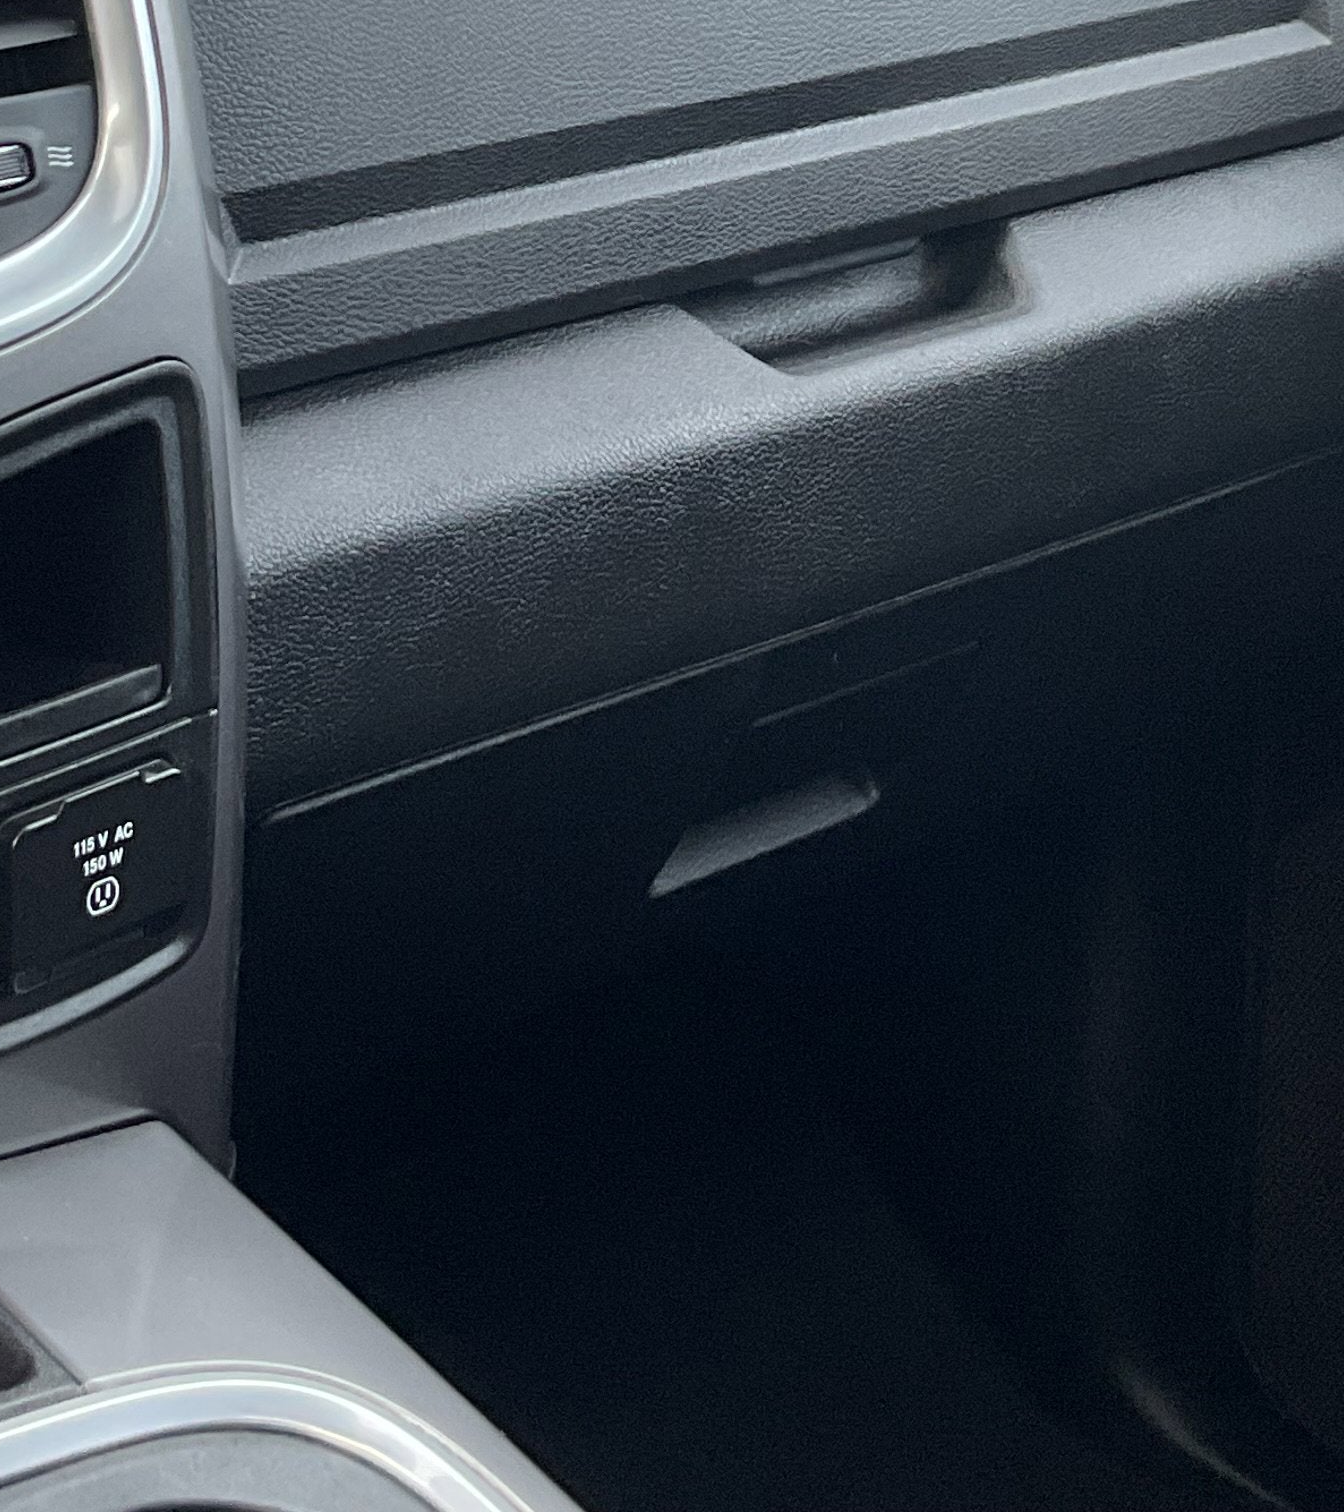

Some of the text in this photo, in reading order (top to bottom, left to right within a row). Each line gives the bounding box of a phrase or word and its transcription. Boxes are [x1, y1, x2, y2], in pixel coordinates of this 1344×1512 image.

[73, 821, 133, 858] 115 V AC
[82, 847, 124, 877] 150 W
